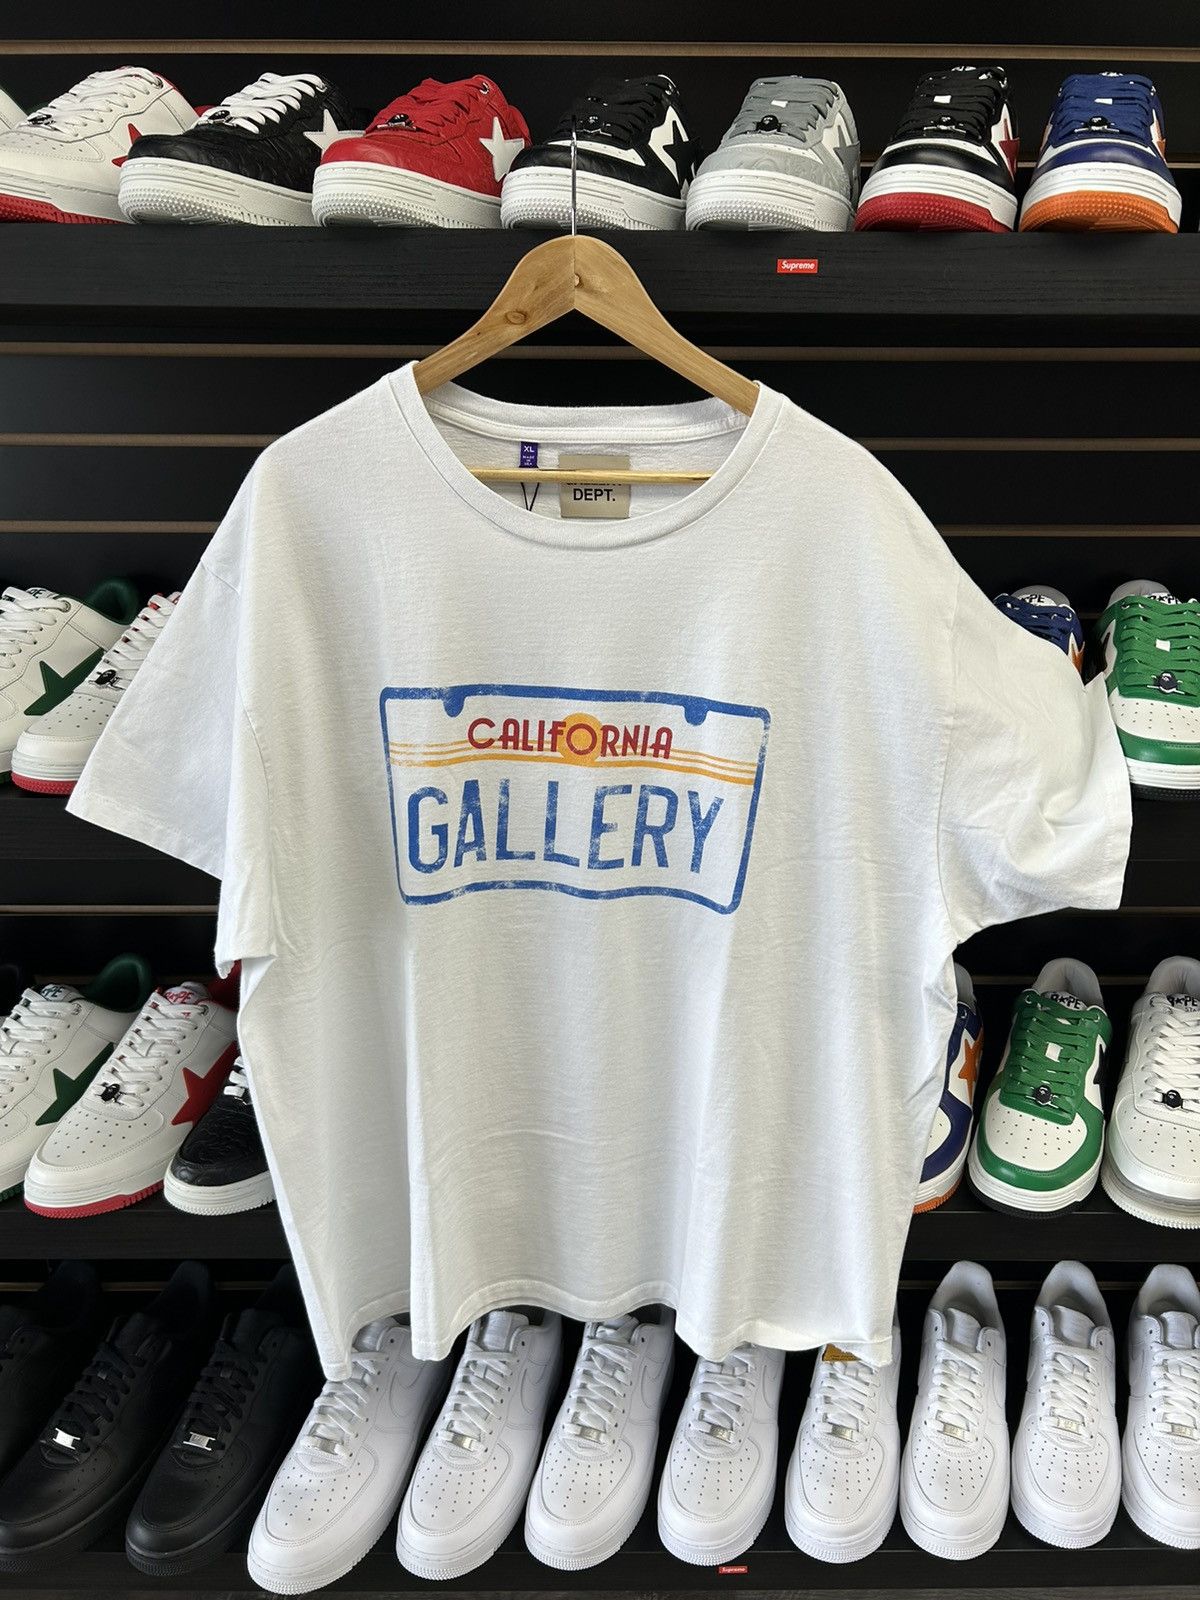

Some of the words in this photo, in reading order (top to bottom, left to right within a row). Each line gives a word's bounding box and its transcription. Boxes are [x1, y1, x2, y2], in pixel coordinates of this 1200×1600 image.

[781, 260, 815, 271] Supreme
[523, 445, 535, 453] XL
[573, 488, 616, 502] DEPT.
[467, 717, 674, 760] CALIFORNIA
[407, 777, 725, 874] GALLERY
